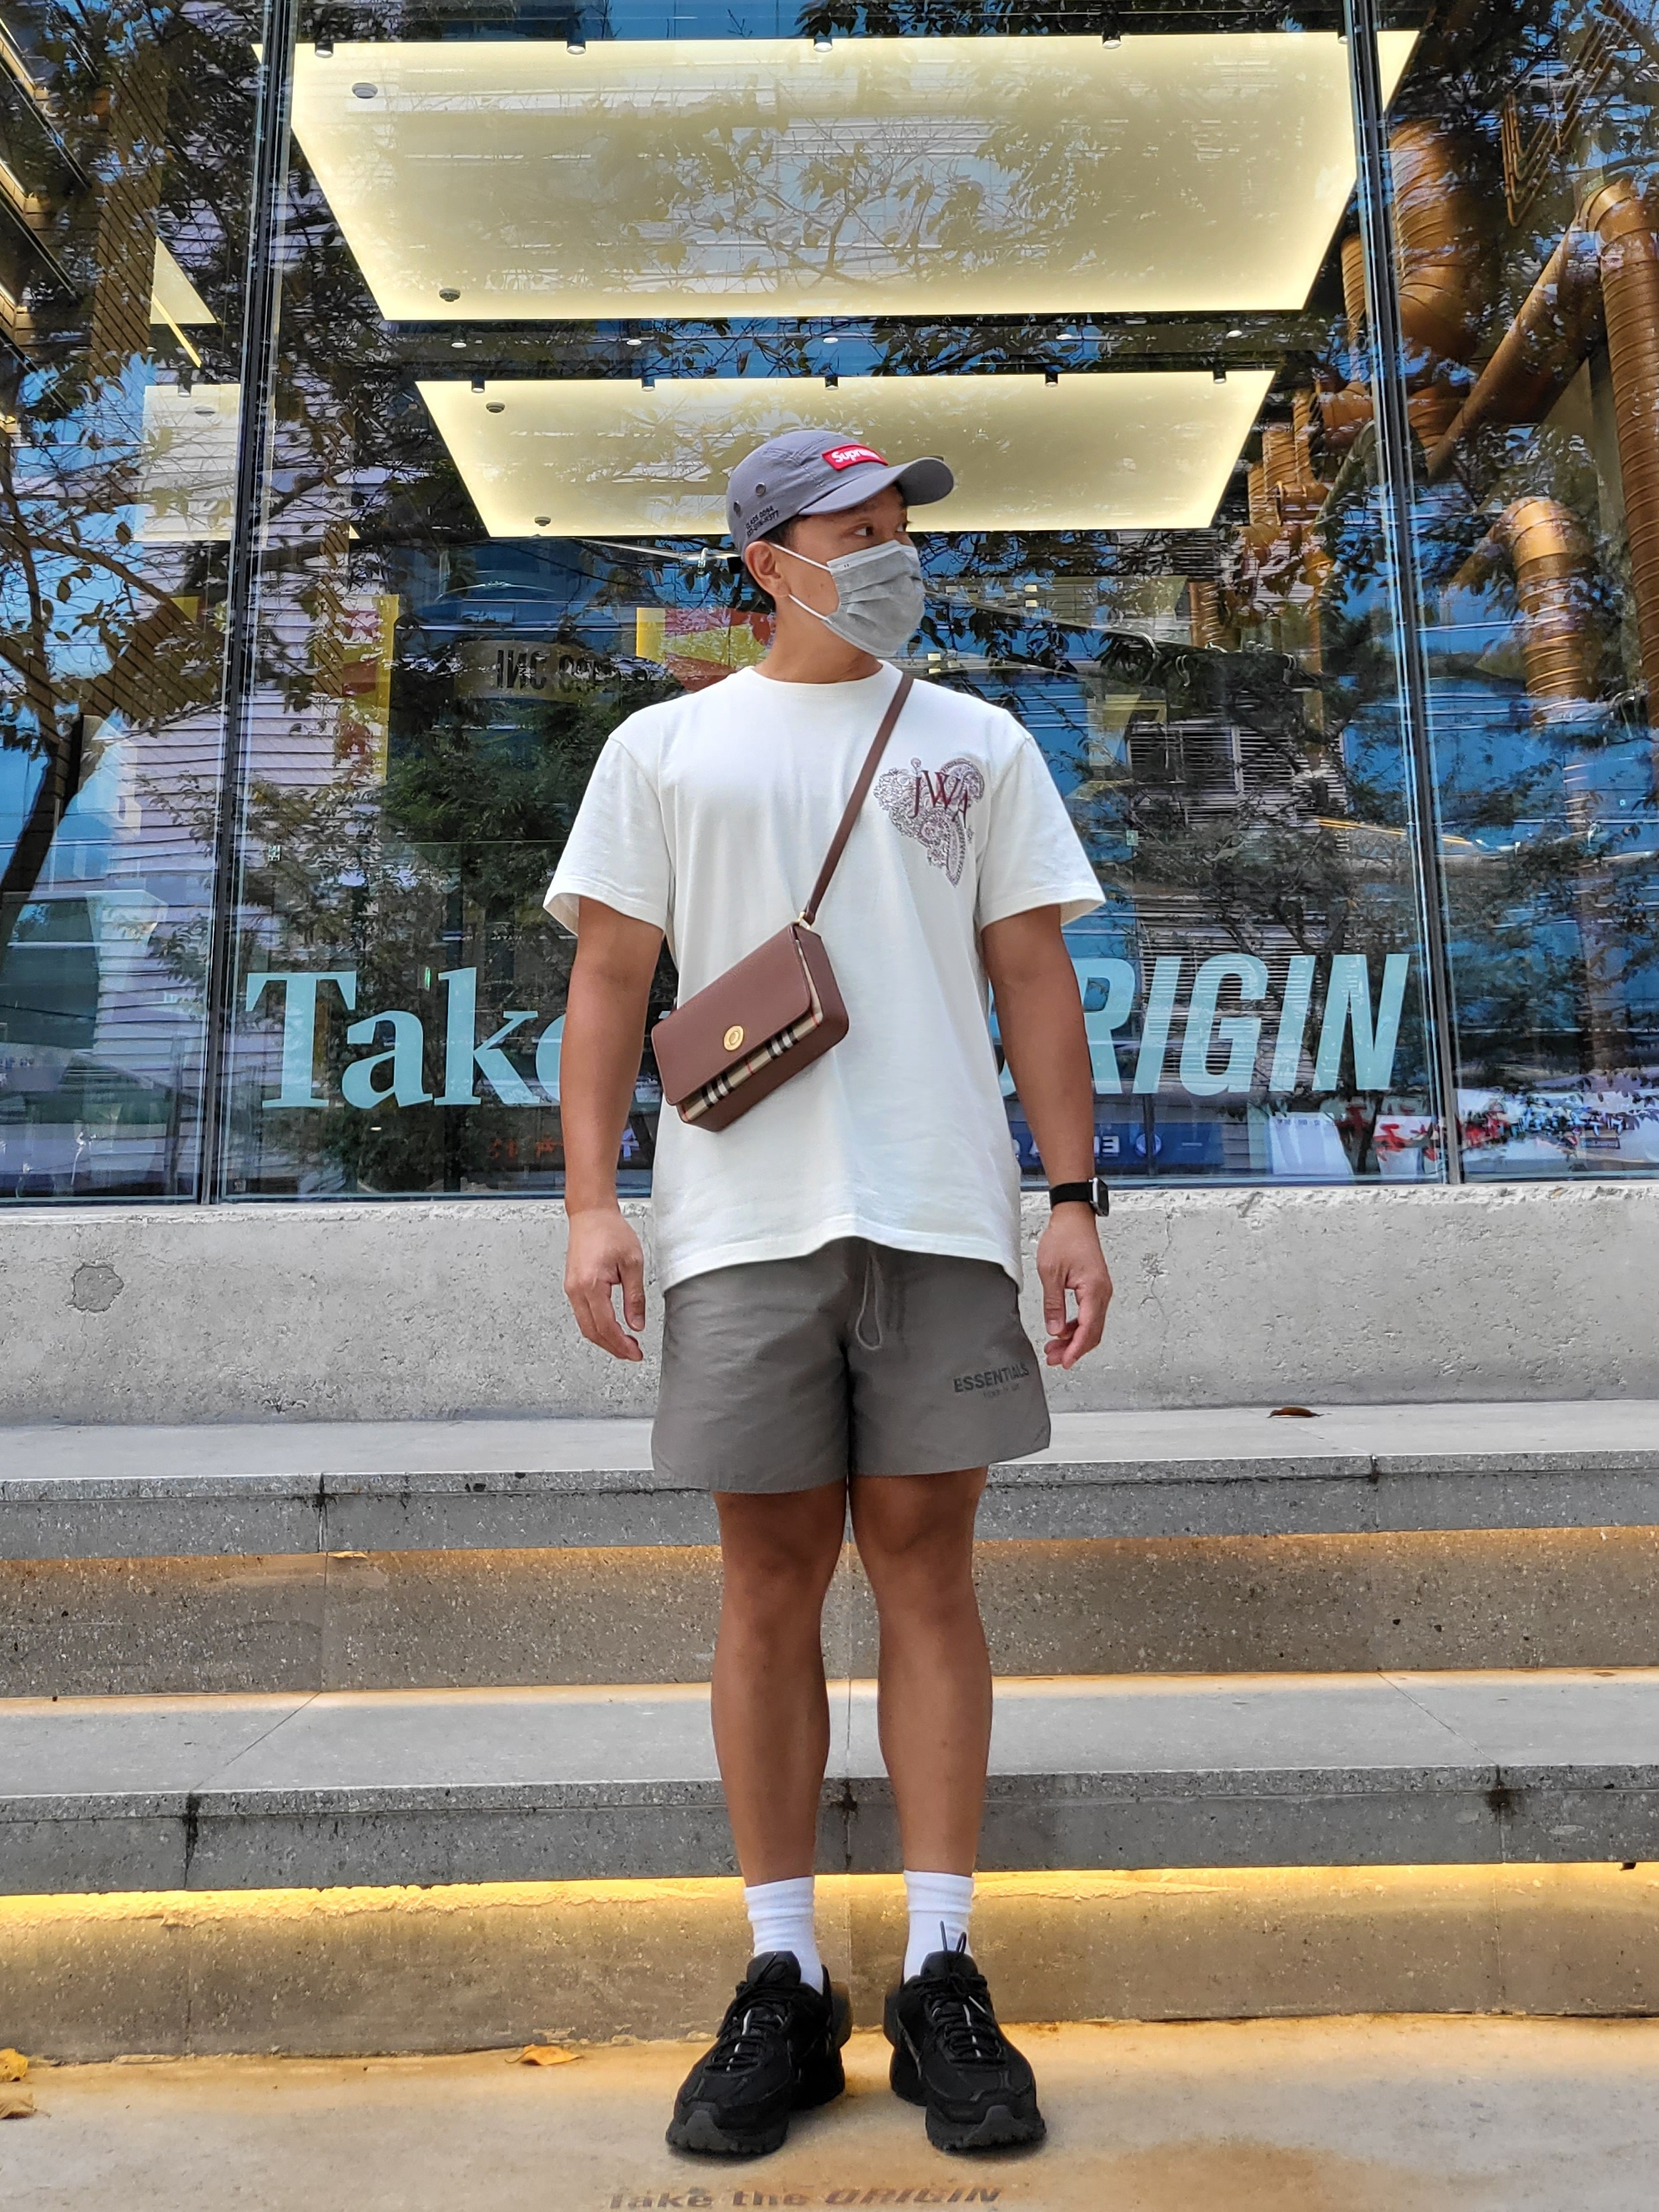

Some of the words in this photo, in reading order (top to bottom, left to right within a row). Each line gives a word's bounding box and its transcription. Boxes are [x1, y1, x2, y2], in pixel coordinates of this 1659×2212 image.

[999, 953, 1410, 1097] RIGIN
[953, 1363, 1030, 1393] ESSENTIALS
[731, 2190, 809, 2207] the
[825, 2186, 1002, 2205] ORIGIN
